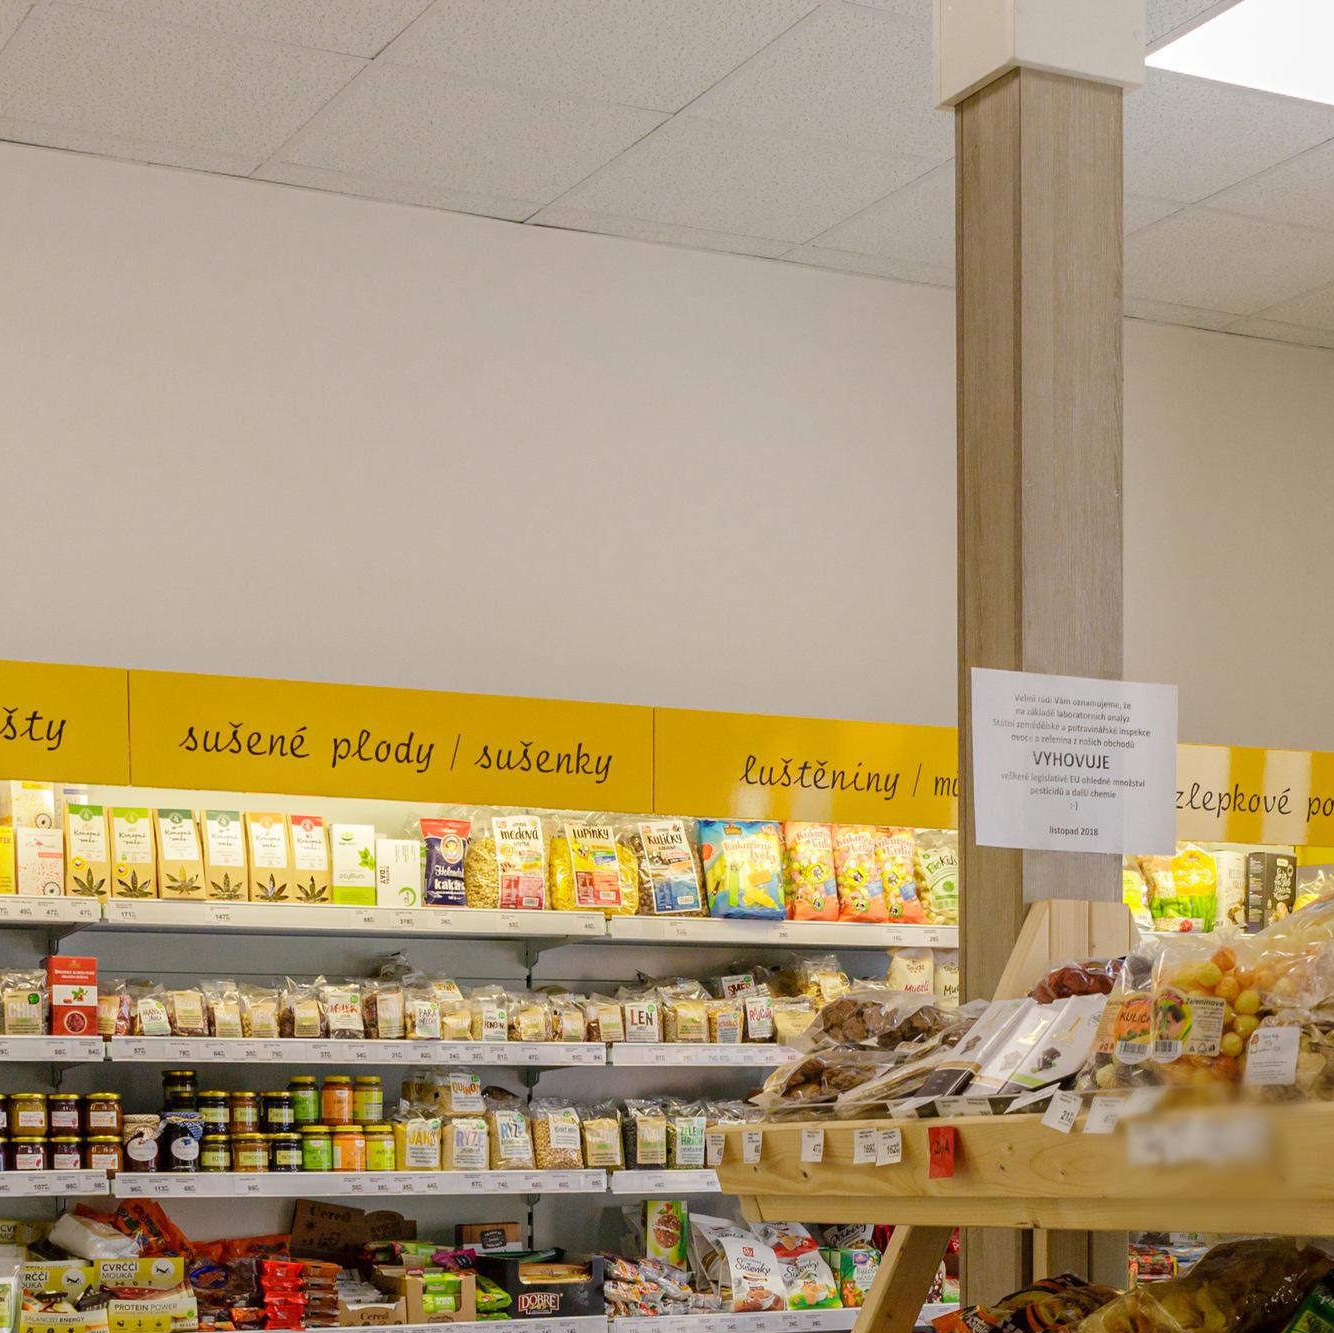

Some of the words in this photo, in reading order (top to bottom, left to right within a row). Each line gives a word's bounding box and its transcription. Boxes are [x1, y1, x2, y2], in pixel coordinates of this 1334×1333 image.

[1013, 693, 1037, 702] Velmi
[1037, 695, 1053, 704] rádi
[1053, 696, 1072, 705] Vám
[1072, 698, 1123, 710] oznamujeme,
[1122, 701, 1132, 710] že
[1026, 708, 1056, 718] základě
[1056, 710, 1107, 721] laboratorních
[1107, 713, 1131, 723] analýz
[991, 718, 1016, 728] Státní
[1015, 721, 1061, 731] zemědělské
[1067, 723, 1118, 736] potravinářské
[1118, 726, 1152, 737] inspekce
[1010, 734, 1034, 742] ovoce
[1040, 735, 1073, 745] zelenina
[1078, 737, 1103, 746] našich
[1102, 738, 1135, 749] obchodů
[180, 722, 310, 759] sušené
[331, 729, 435, 771] plody
[474, 740, 614, 785] sušenky
[1032, 751, 1111, 769] VYHOVUJE
[739, 755, 901, 803] luštěniny
[1000, 771, 1030, 781] veškeré
[1030, 773, 1069, 784] legislativě
[1069, 776, 1081, 784] EU
[1081, 775, 1112, 786] ohledně
[1112, 777, 1146, 788] množství
[1029, 787, 1065, 797] pesticidů
[1071, 788, 1090, 796] další
[1090, 789, 1117, 799] chemie
[1175, 787, 1291, 819] zlepkové
[1048, 826, 1080, 837] listopad
[1080, 826, 1099, 836] 2018
[630, 1009, 653, 1026] LEN
[102, 1262, 138, 1272] CVRČČÍ
[114, 1303, 149, 1311] PROTEIN
[150, 1302, 177, 1311] POWER
